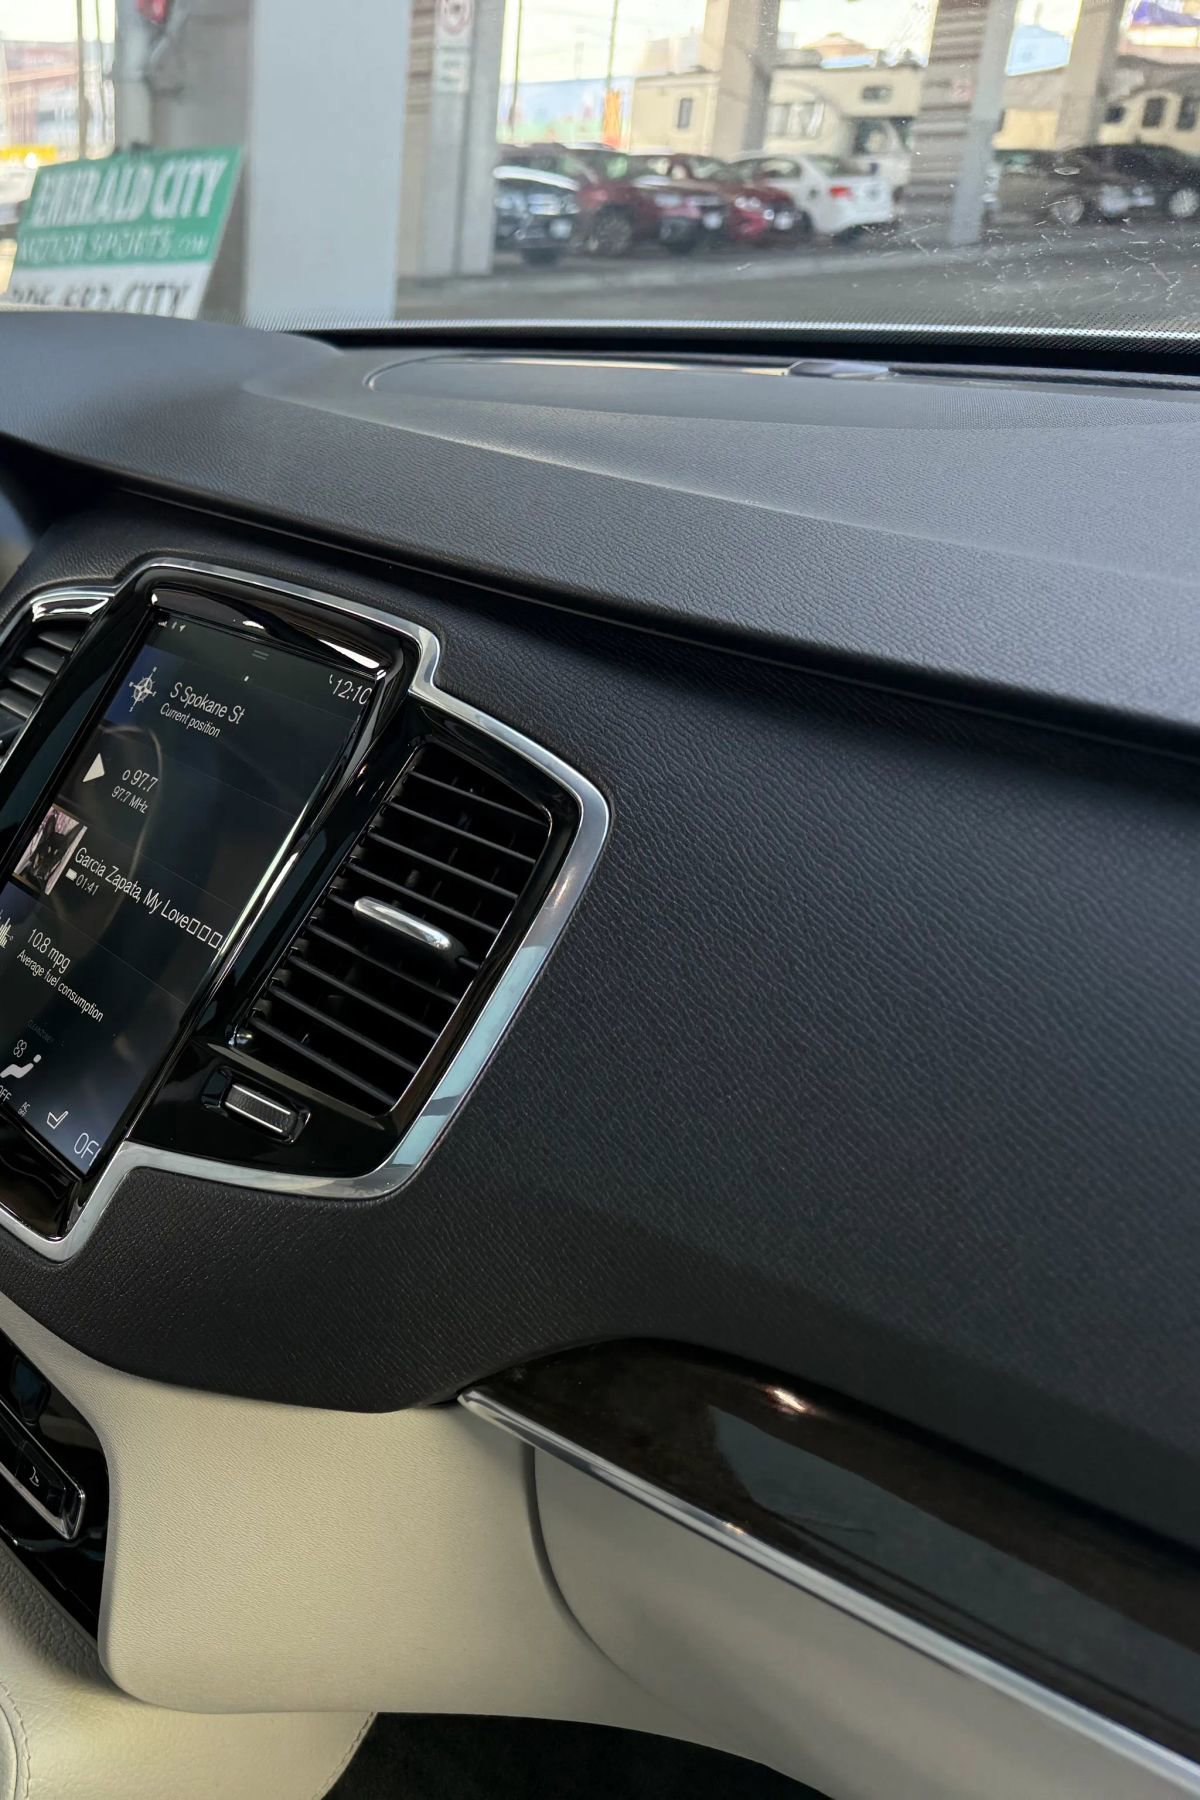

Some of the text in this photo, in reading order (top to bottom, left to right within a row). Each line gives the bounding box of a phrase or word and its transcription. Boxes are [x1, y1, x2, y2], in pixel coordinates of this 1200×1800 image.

[31, 156, 229, 228] EMERALD CITY
[169, 682, 246, 724] S Spokane St
[332, 679, 373, 705] 12:10
[160, 702, 221, 738] Current position
[111, 785, 148, 814] 97.7 MHz
[131, 769, 159, 792] 97.7
[75, 847, 106, 877] Garcia
[105, 865, 142, 904] Zapata,
[142, 888, 163, 915] My
[75, 874, 100, 896] 01:41
[28, 928, 71, 974] 10.8 mpg
[16, 949, 104, 1022] Average fuel consumption
